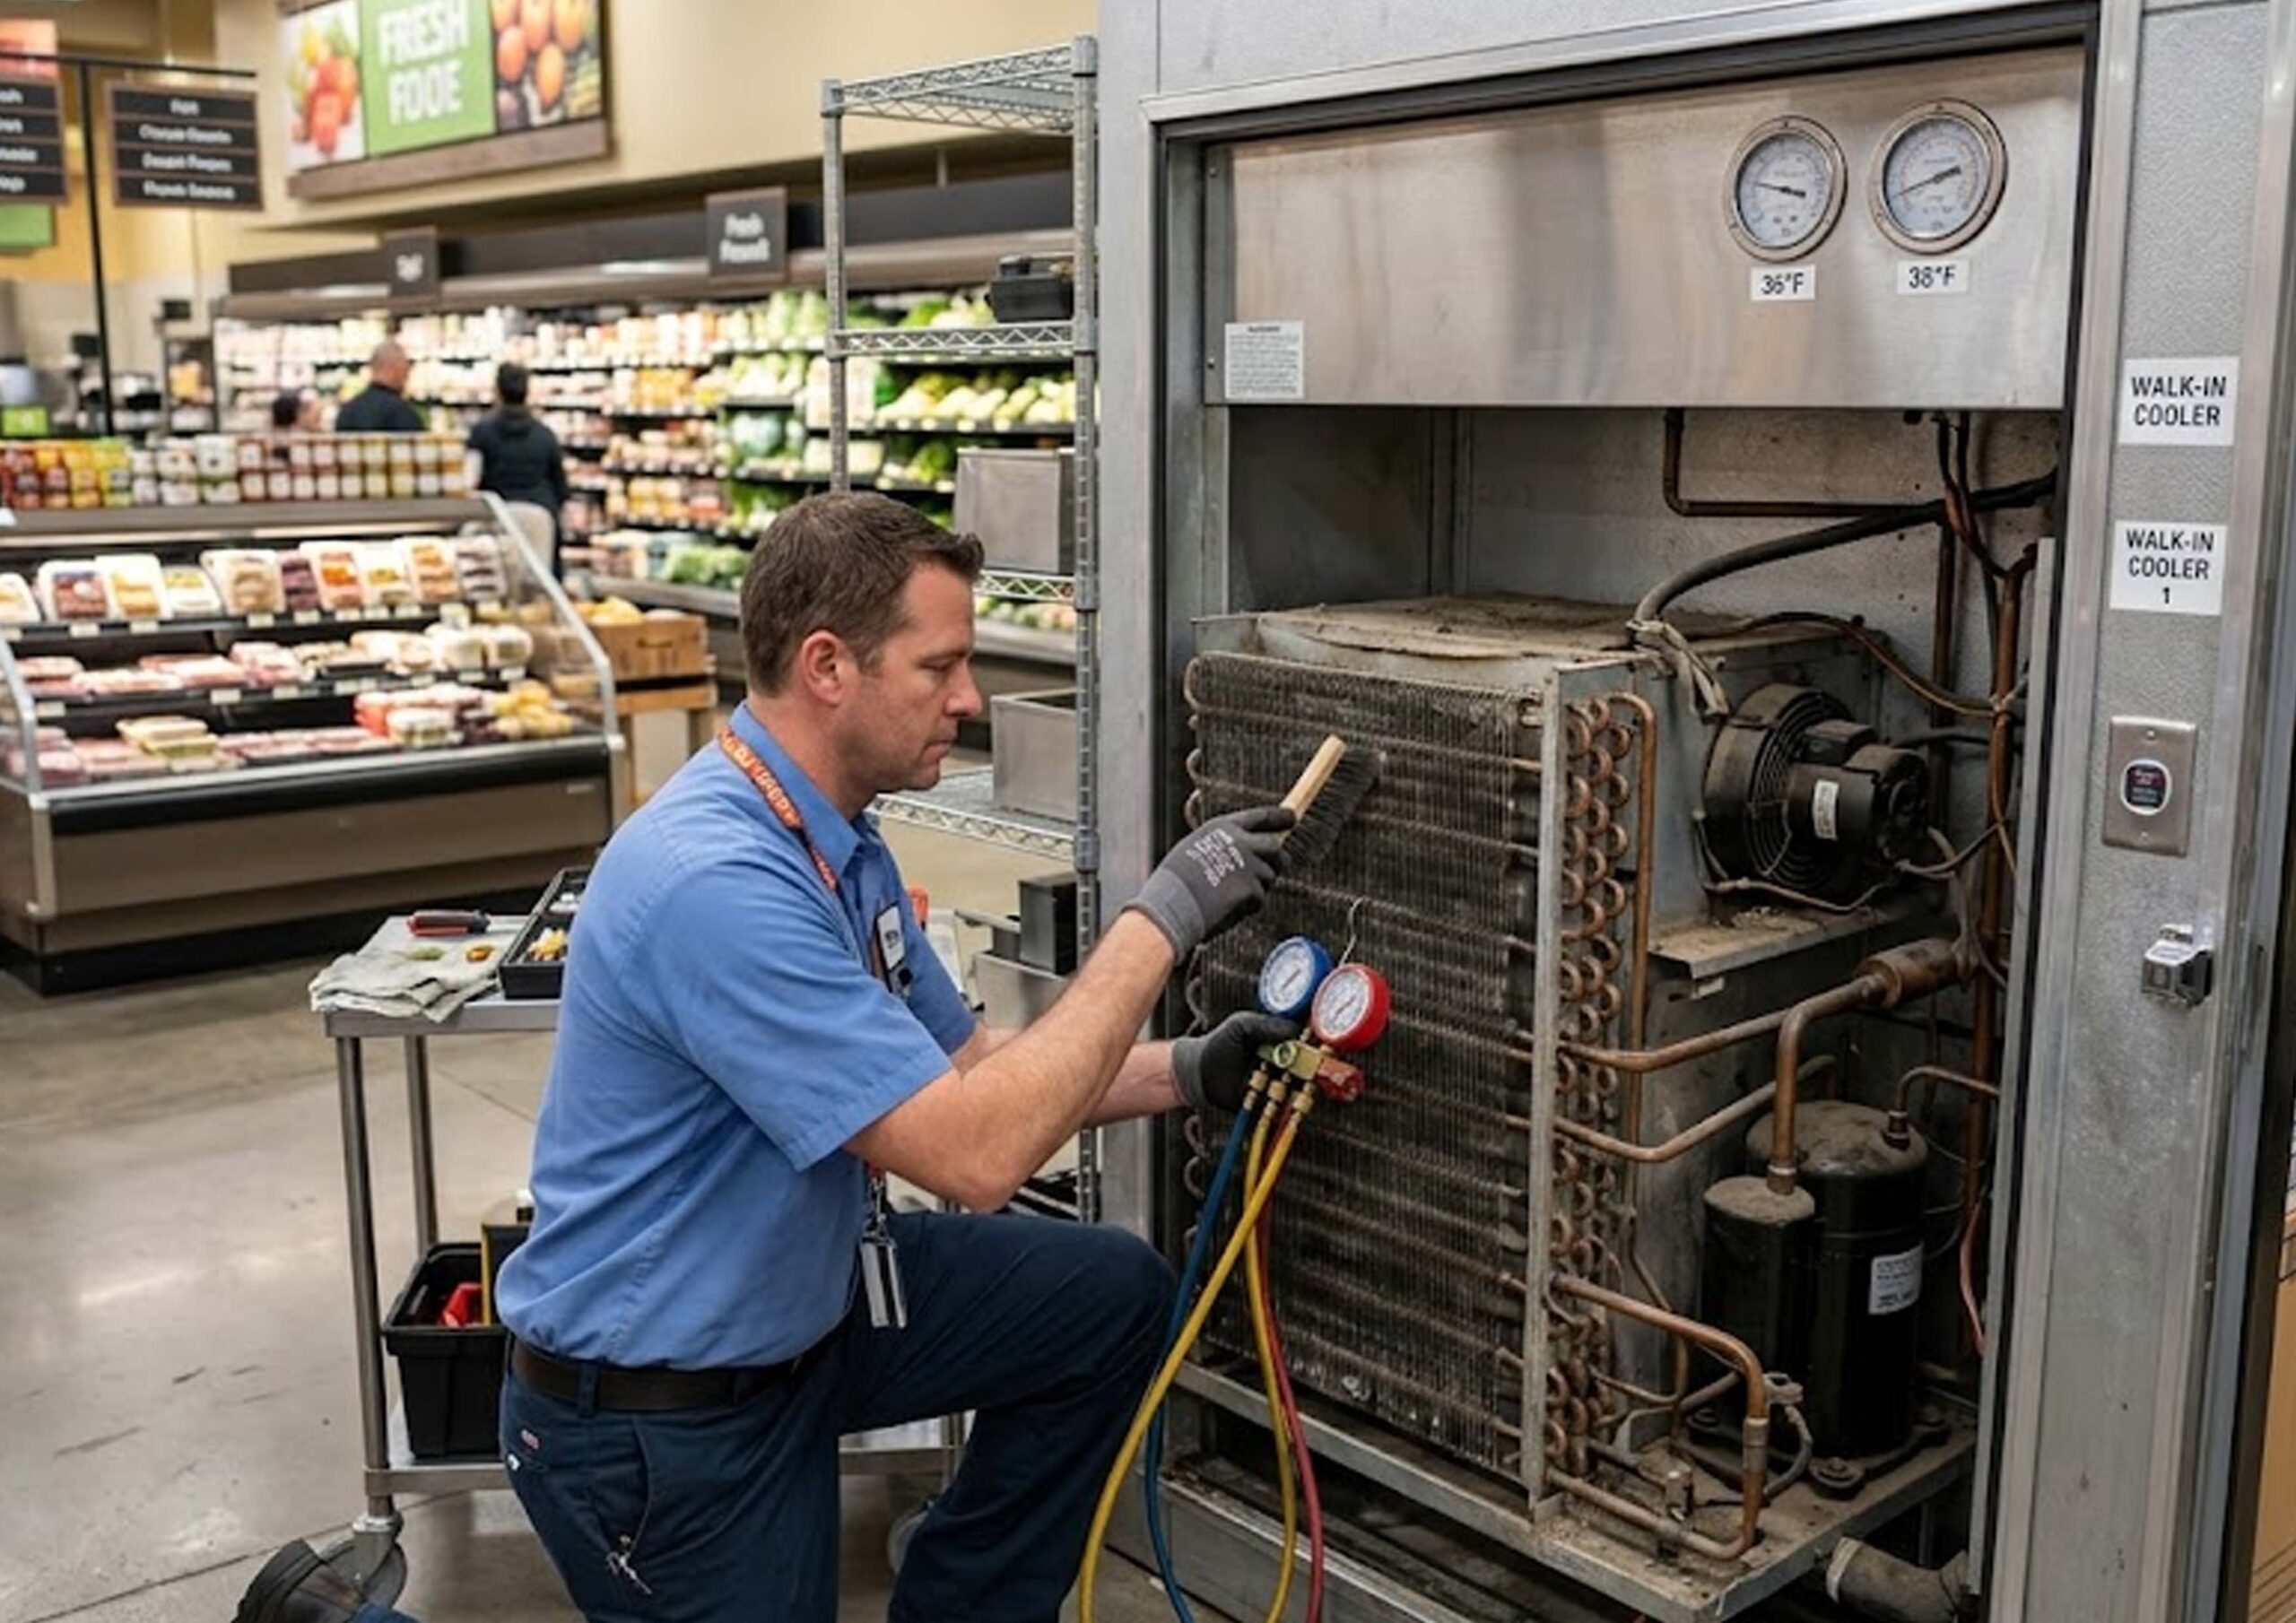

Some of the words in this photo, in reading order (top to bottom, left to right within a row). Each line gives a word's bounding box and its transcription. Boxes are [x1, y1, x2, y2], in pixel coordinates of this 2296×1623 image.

[378, 0, 467, 66] FRESH
[1761, 272, 1805, 295] 36°F
[1908, 265, 1957, 290] 38°F
[2131, 376, 2227, 397] WALK-IN
[2134, 404, 2221, 426] COOLER
[2126, 528, 2214, 551] WALK-IN
[2128, 555, 2209, 580] COOLER
[2162, 586, 2170, 604] 1
